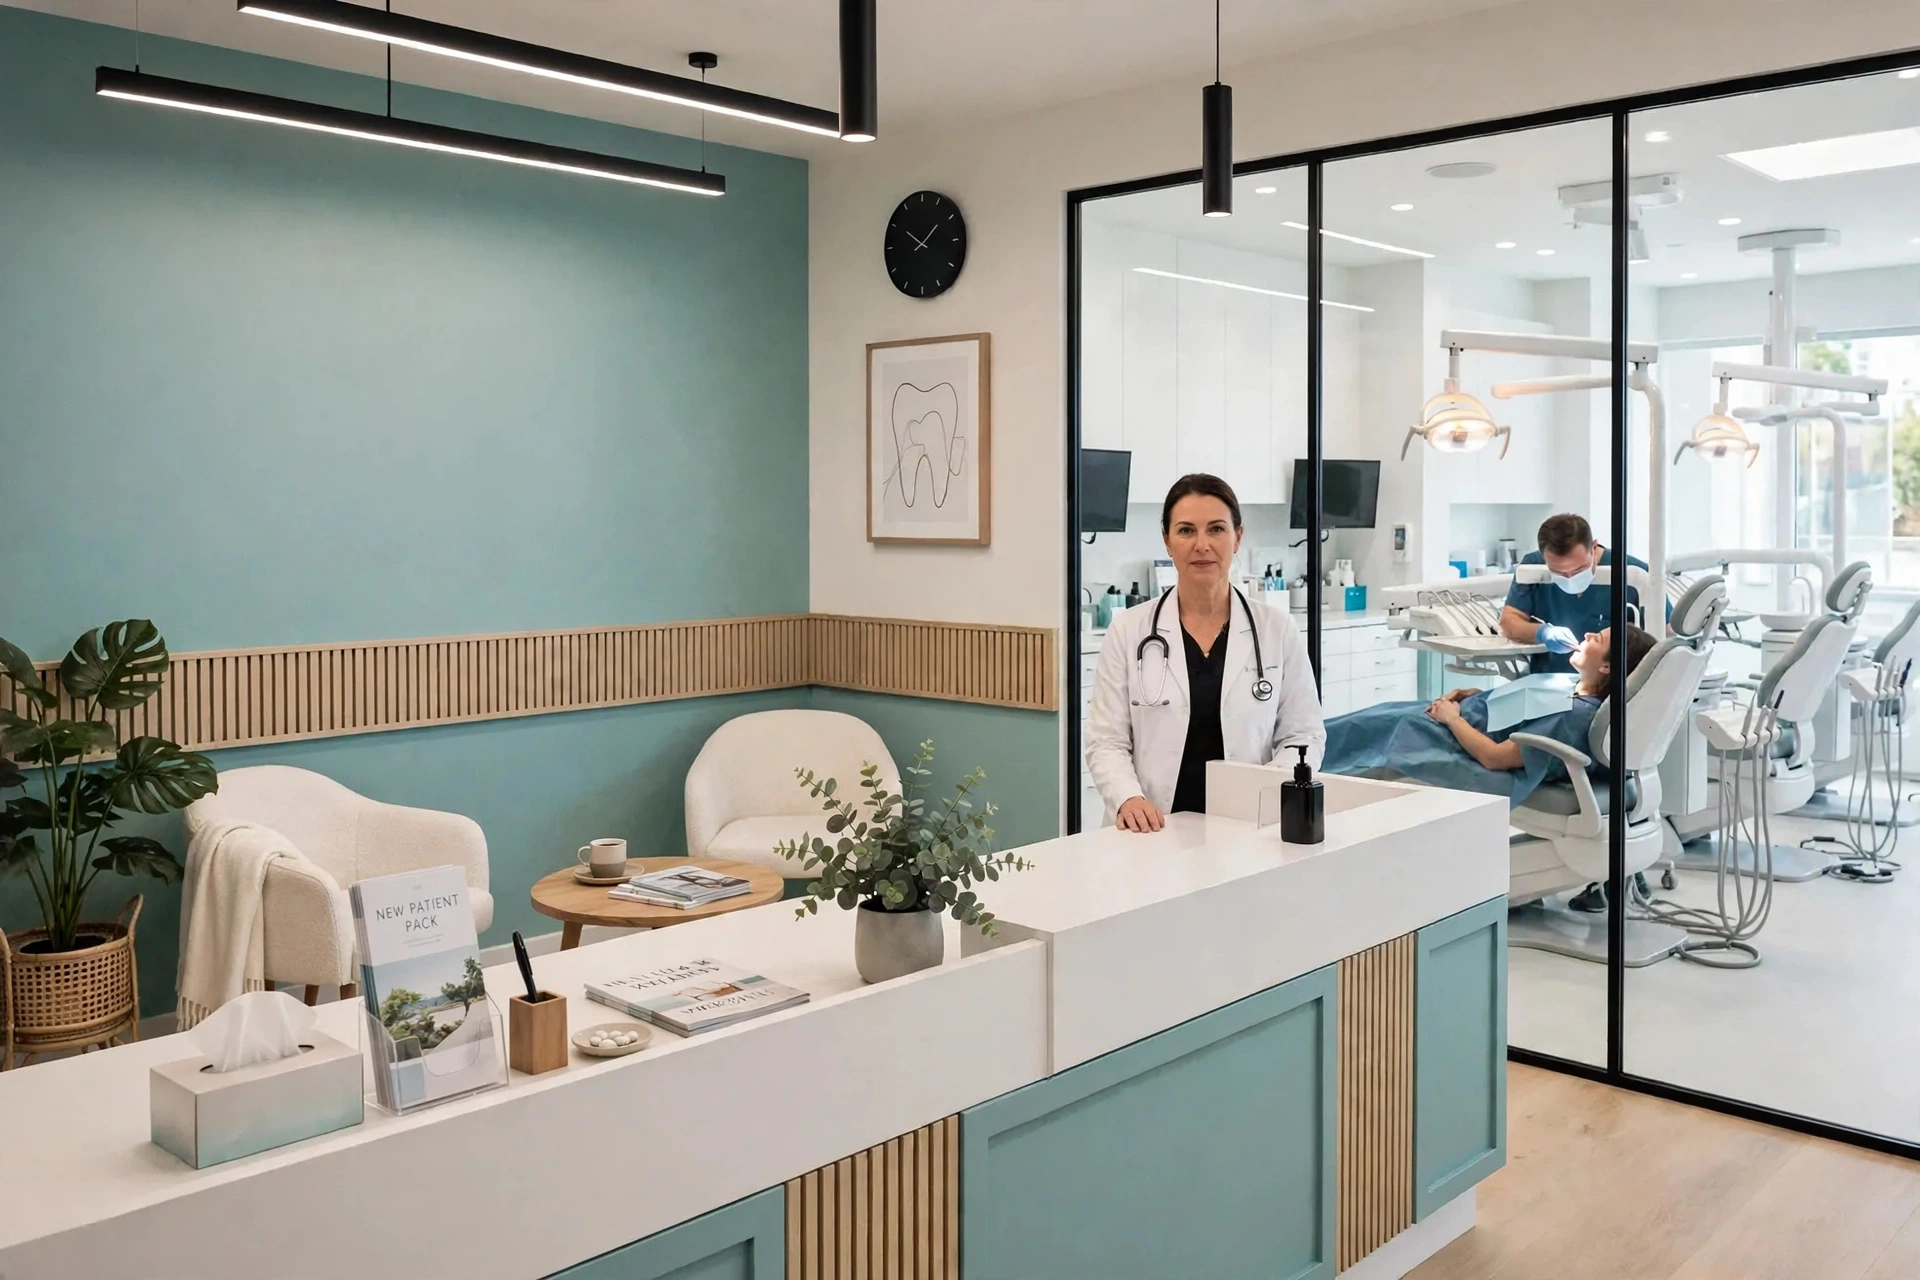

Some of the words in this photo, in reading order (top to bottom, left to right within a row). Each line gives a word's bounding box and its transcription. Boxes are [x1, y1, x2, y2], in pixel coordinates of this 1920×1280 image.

[376, 905, 404, 921] NEW
[409, 894, 459, 914] PATIENT
[405, 915, 438, 932] PACK
